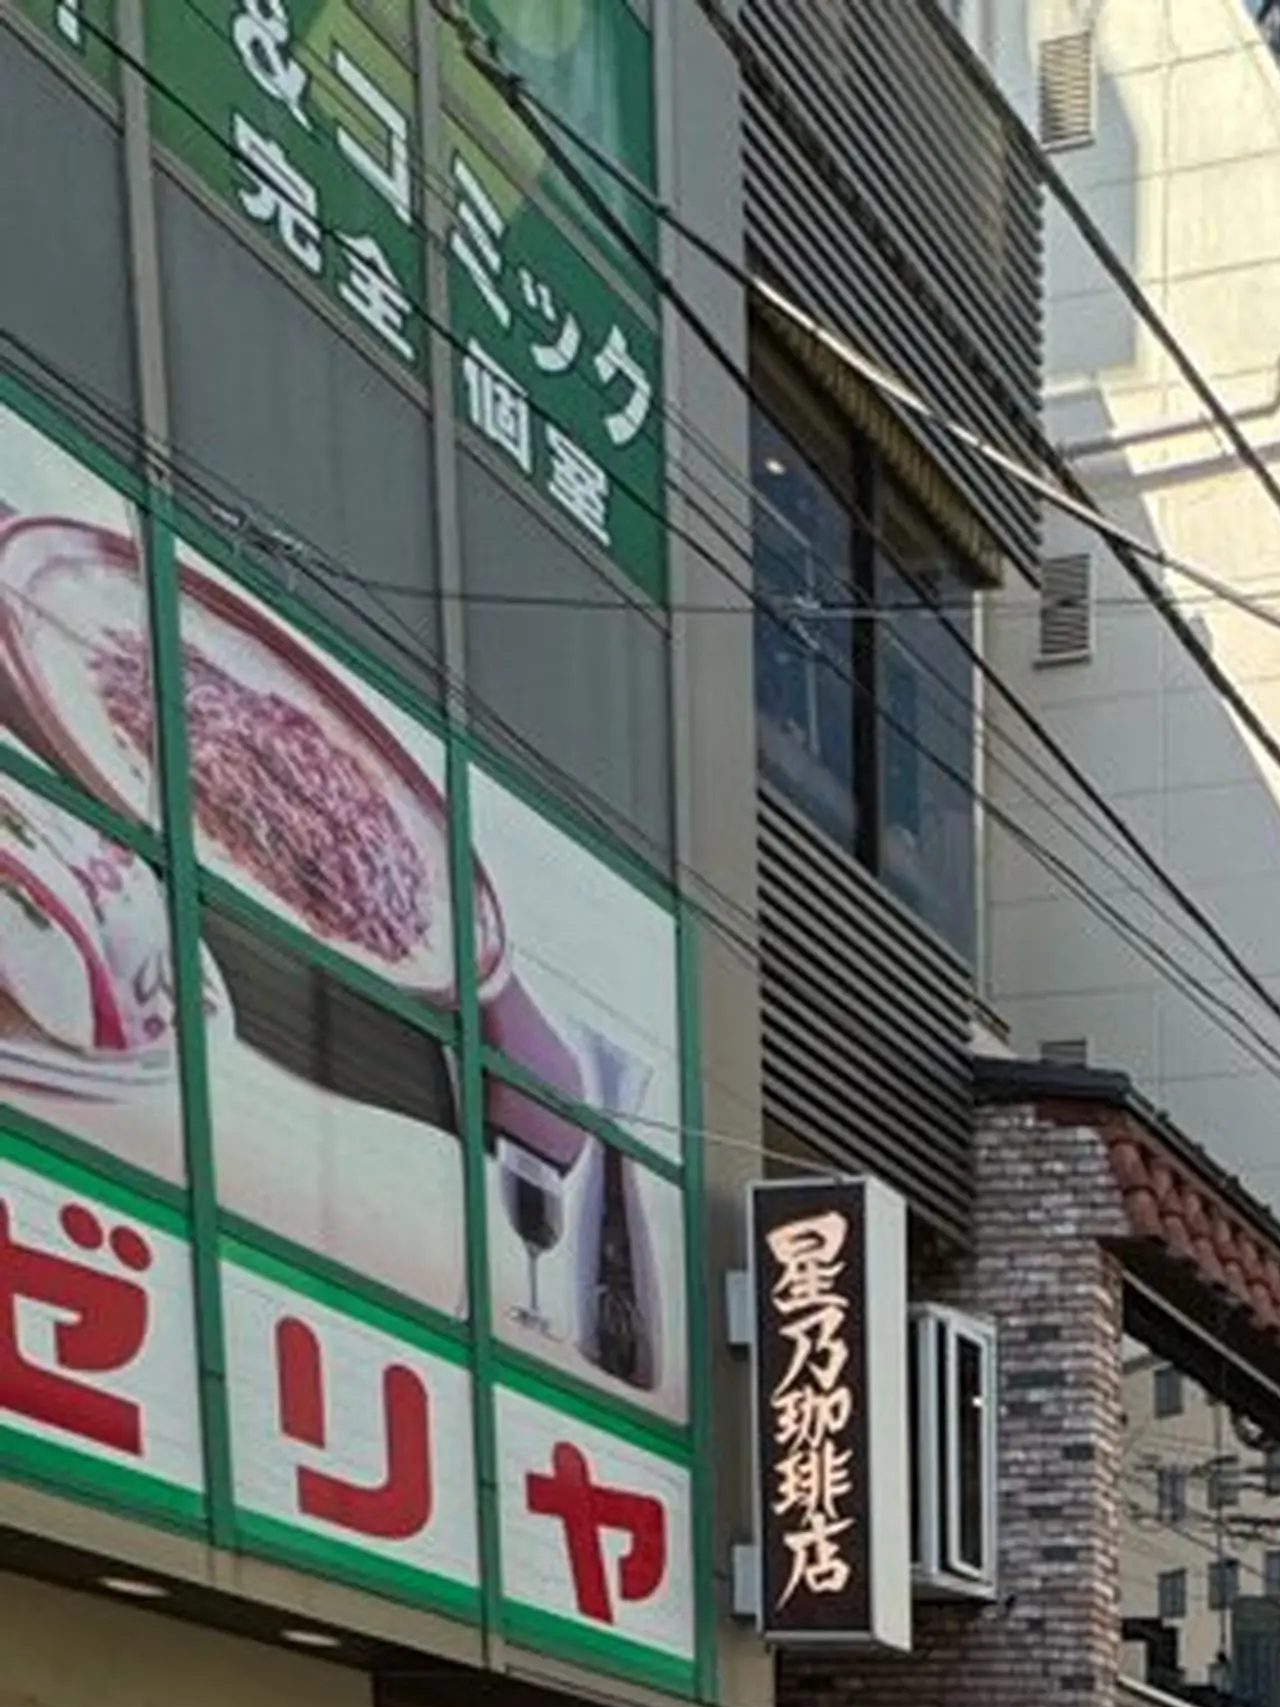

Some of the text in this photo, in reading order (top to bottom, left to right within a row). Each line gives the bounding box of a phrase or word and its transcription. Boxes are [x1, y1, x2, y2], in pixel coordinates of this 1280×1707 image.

[232, 111, 611, 547] 完全個室
[765, 1211, 855, 1611] 星乃珈琲店
